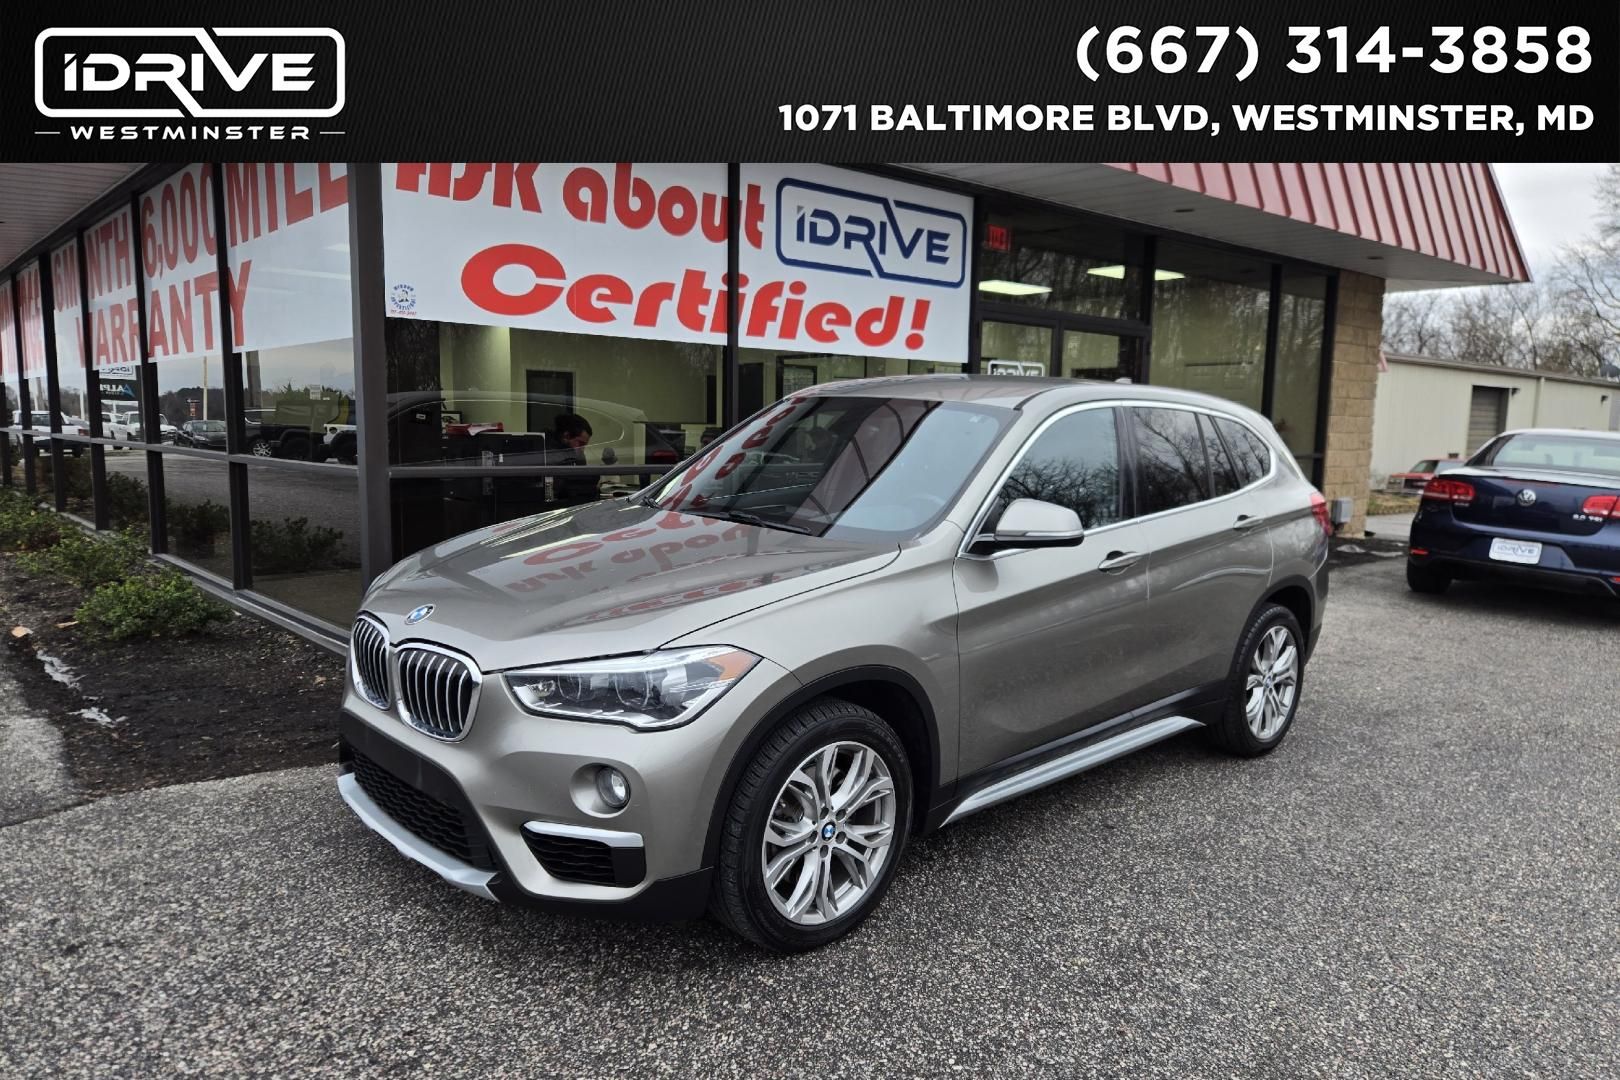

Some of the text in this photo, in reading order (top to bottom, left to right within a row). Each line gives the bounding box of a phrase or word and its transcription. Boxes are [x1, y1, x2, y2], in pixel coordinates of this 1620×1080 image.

[63, 212, 132, 310] MNTH
[141, 163, 217, 281] 6,000
[562, 163, 765, 250] about
[460, 243, 931, 350] Certified!
